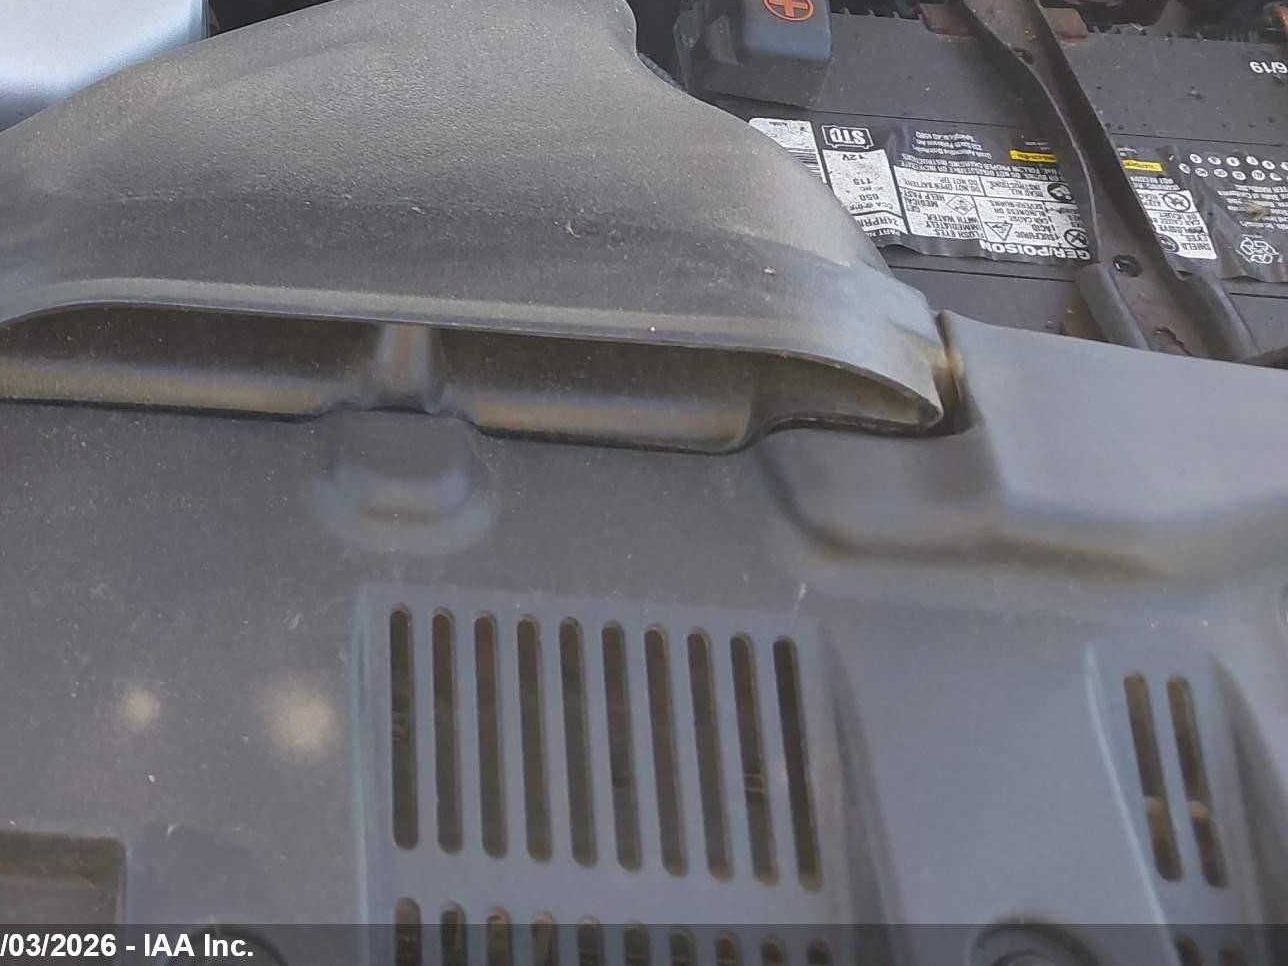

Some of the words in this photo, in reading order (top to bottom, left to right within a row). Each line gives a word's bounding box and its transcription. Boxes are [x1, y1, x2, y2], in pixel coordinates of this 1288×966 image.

[829, 127, 866, 145] STD
[841, 153, 865, 161] 12V
[903, 196, 939, 208] MEDICAL
[925, 220, 981, 231] IMMEDIATELY
